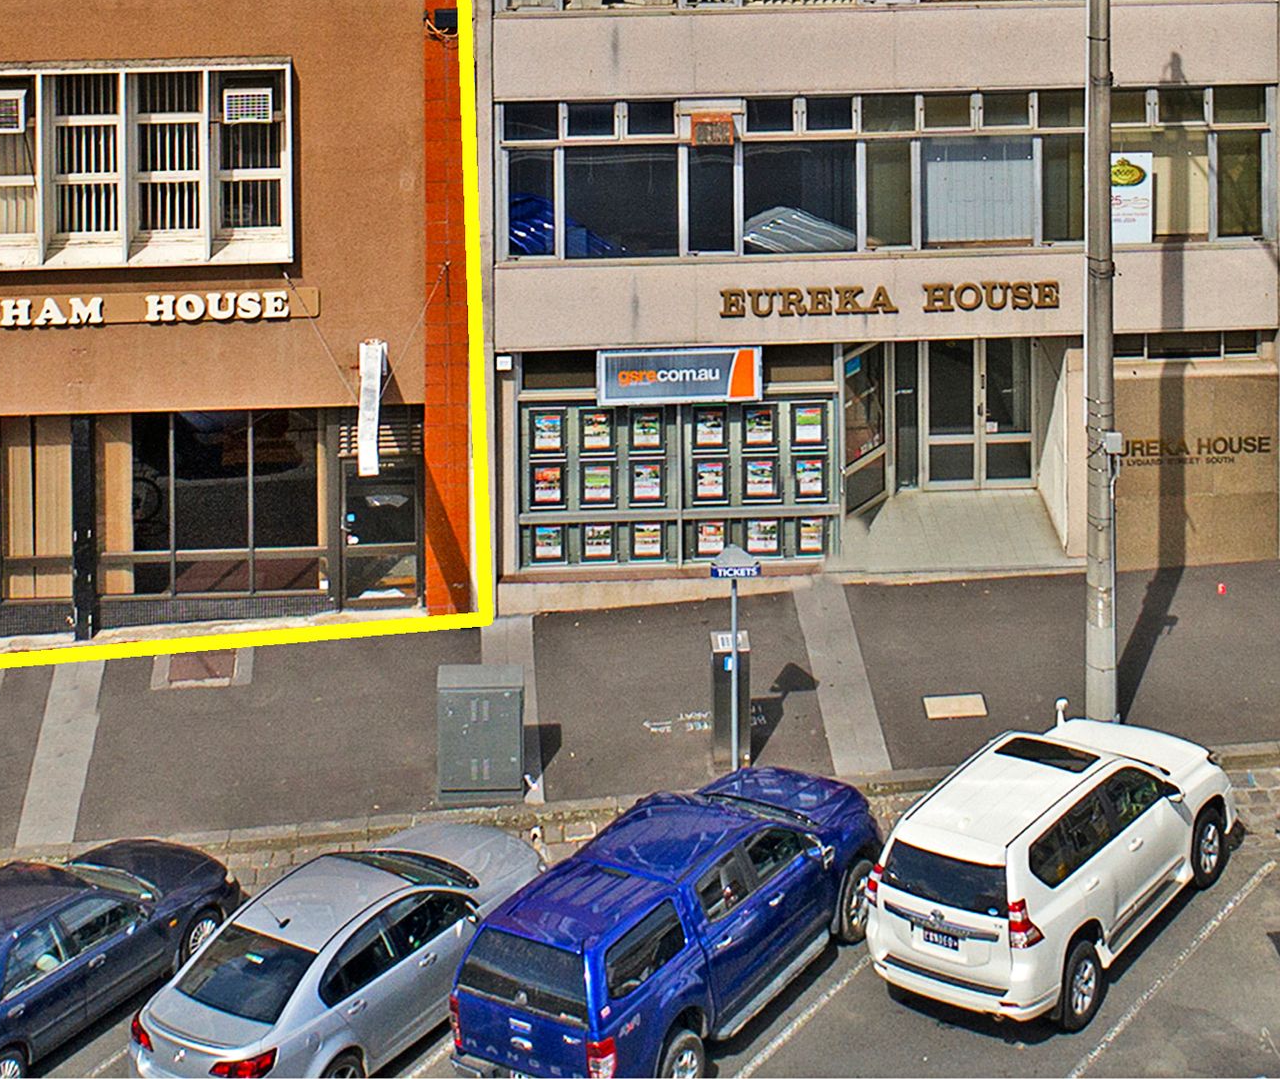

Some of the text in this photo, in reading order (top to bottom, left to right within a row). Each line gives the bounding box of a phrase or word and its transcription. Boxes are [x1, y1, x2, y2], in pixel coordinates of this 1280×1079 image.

[144, 290, 290, 322] HOUSE
[720, 279, 1060, 318] EUREKA HOUSE
[1116, 436, 1271, 457] UREKA HOUSE
[1205, 456, 1235, 465] SOUTH
[717, 567, 758, 577] TICKETS
